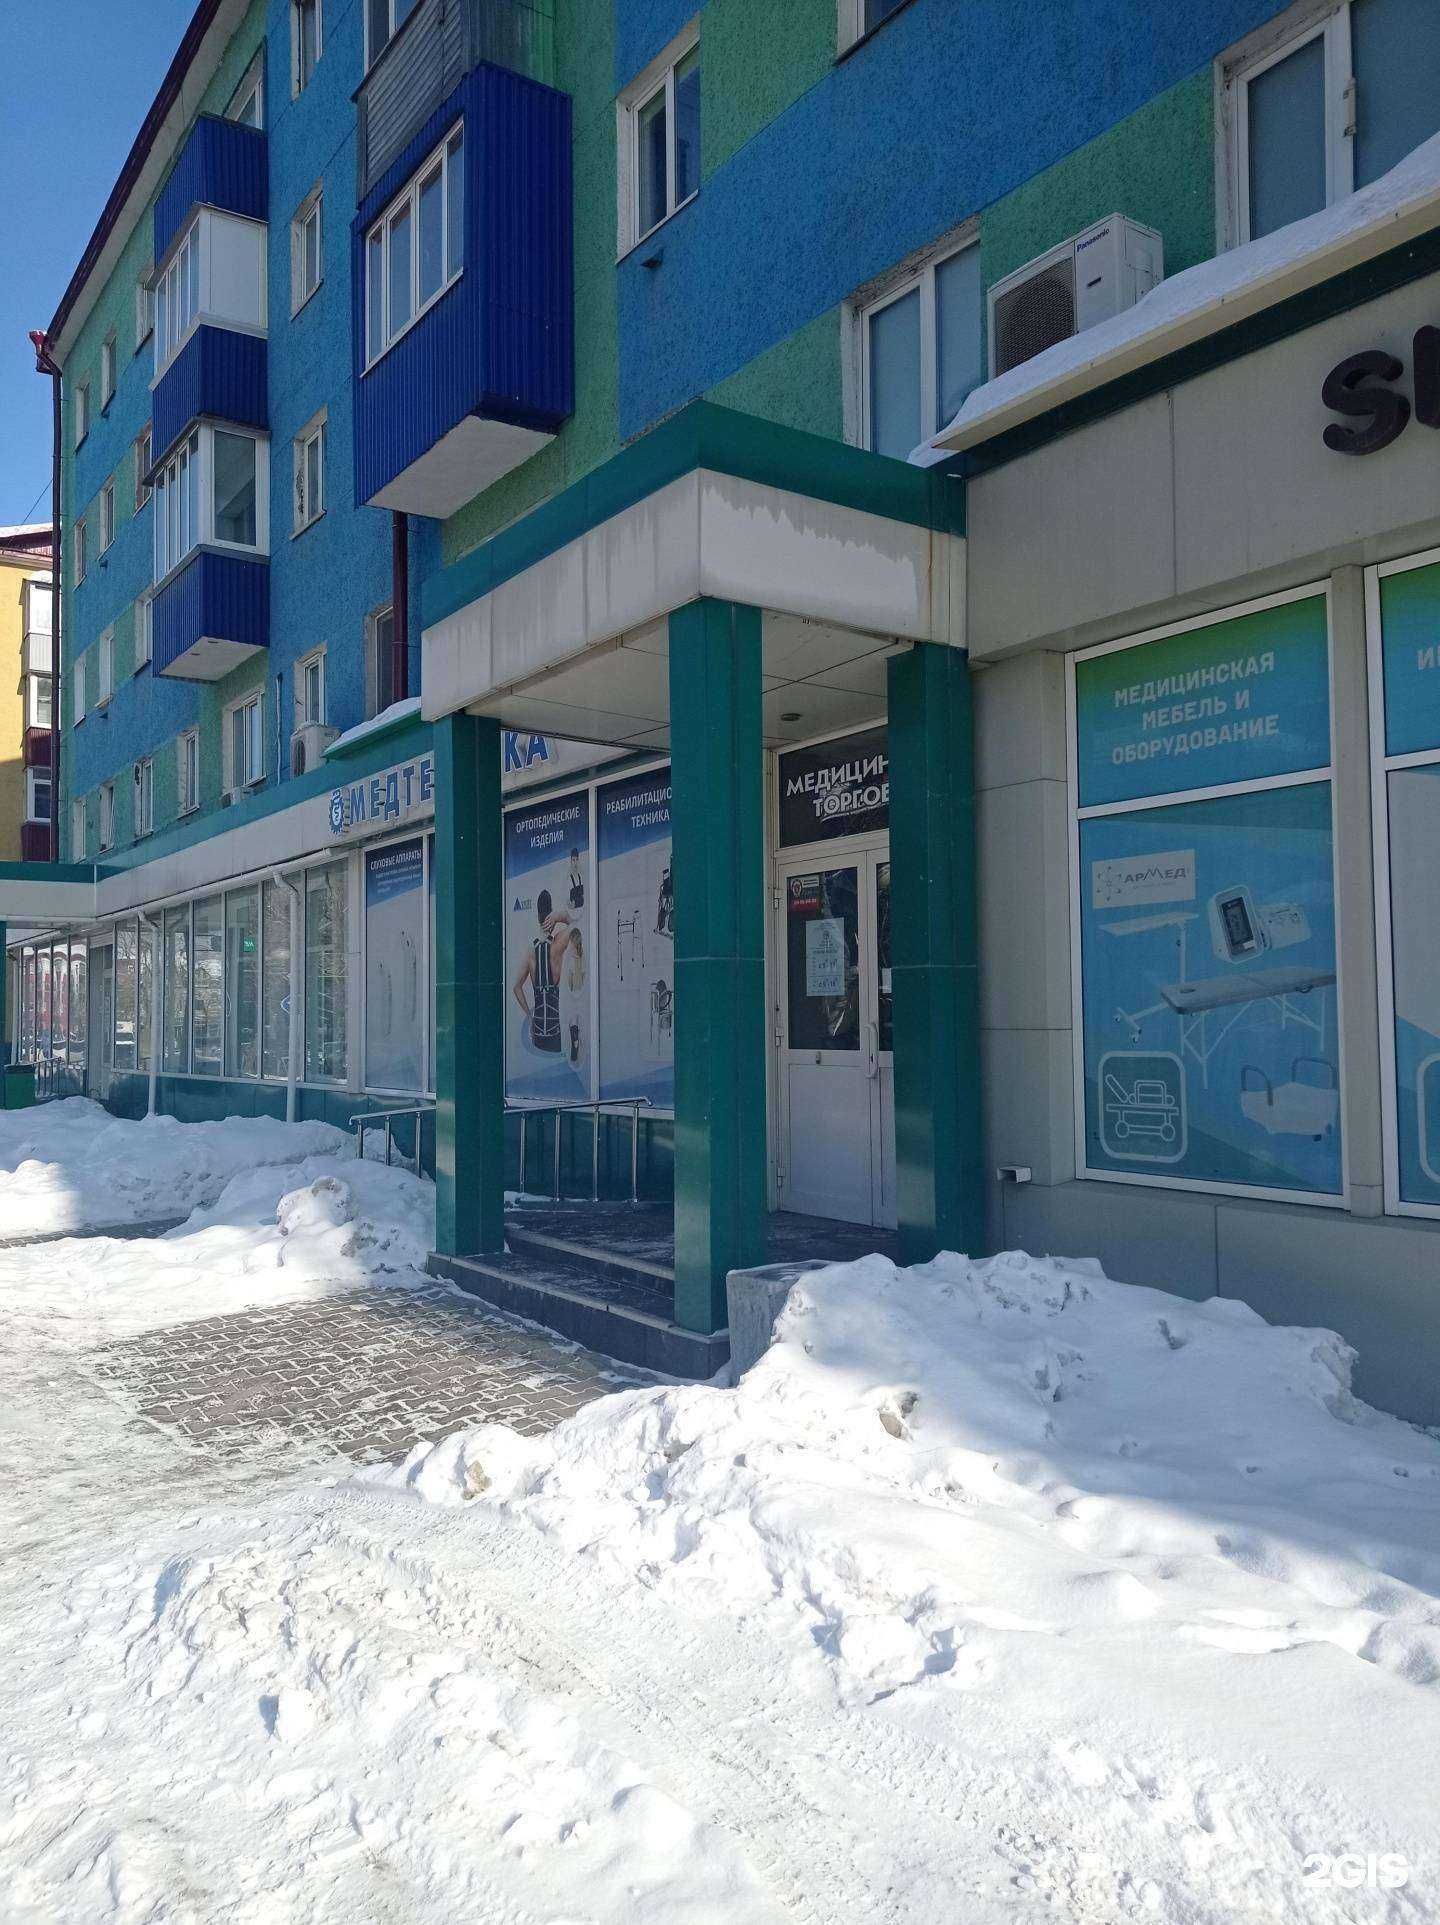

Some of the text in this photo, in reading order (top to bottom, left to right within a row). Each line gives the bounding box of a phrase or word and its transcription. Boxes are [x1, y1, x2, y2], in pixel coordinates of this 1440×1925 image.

[1076, 227, 1111, 252] Panasonic
[1416, 644, 1440, 670] И
[1113, 651, 1275, 708] МЕДИЦИНСКАЯ
[1142, 689, 1251, 731] МЕБЕЛЬ И
[1111, 714, 1280, 766] ОБОРУДОВАНИЕ
[515, 806, 581, 834] ОРТОПЕДИЧЕСКИЕ
[631, 808, 670, 829] ТЕХНИКА
[530, 830, 564, 849] ИЗДЕЛИЯ
[1124, 867, 1186, 884] АРМЕД
